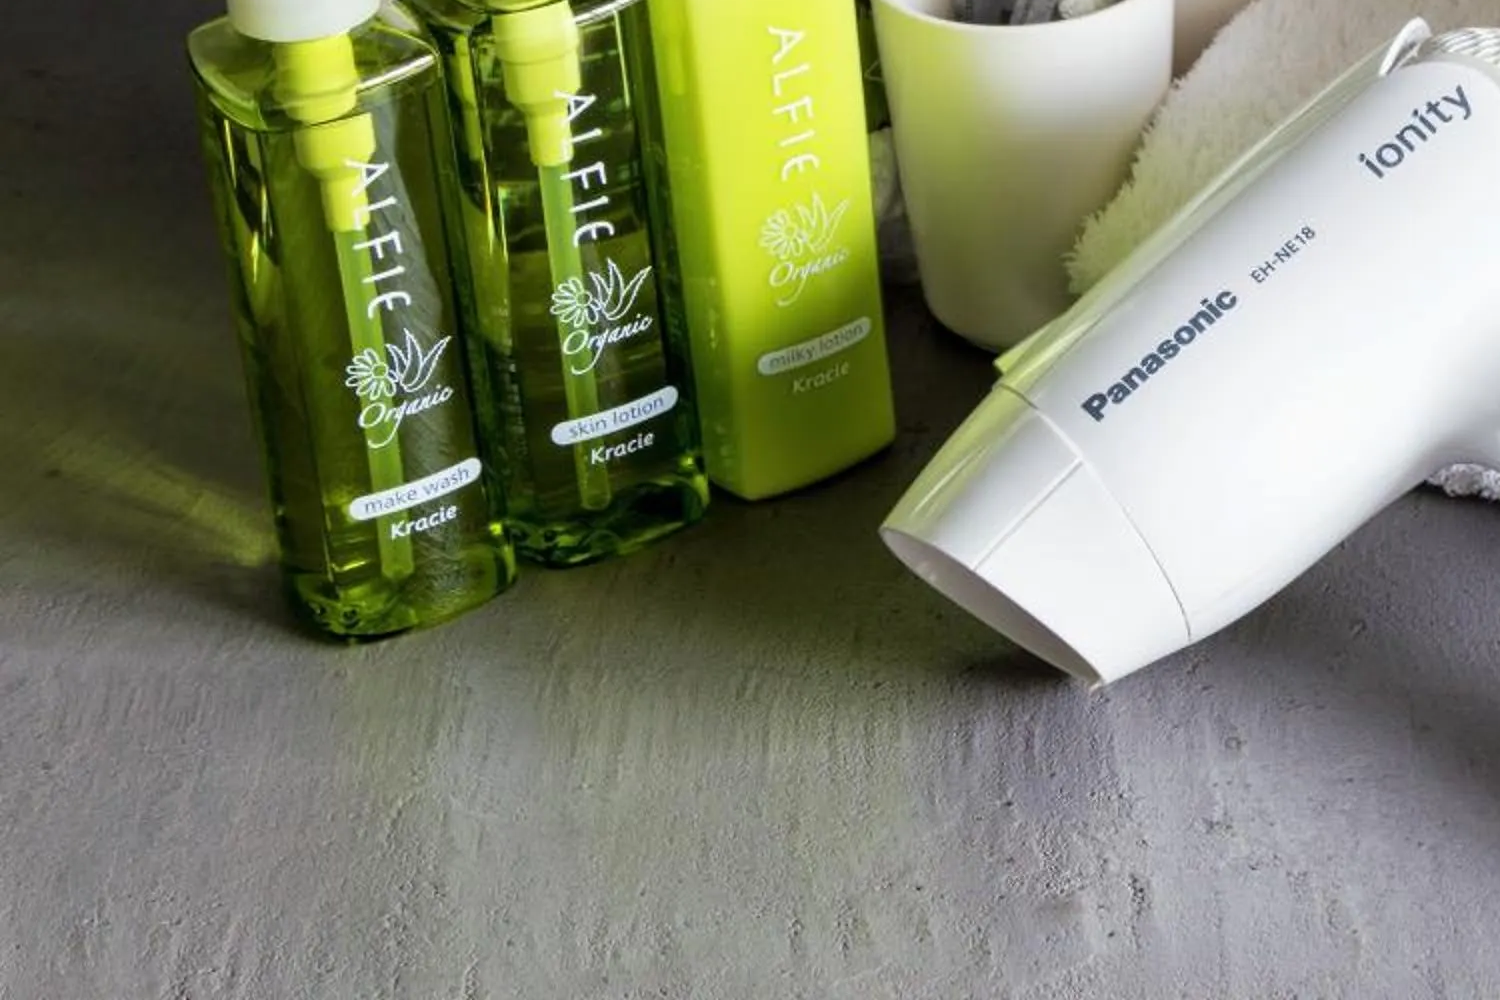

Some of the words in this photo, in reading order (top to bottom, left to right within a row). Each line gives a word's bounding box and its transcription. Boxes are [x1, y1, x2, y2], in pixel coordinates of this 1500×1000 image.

[768, 26, 819, 181] ALFIE
[1359, 84, 1471, 179] ionity
[553, 88, 616, 249] ALFIE
[343, 158, 412, 319] ALFIE
[1250, 225, 1316, 284] EH-NE18
[768, 249, 850, 307] Organic
[563, 313, 654, 376] Organic
[769, 346, 815, 369] milky
[818, 324, 865, 353] lotion
[1080, 290, 1238, 422] Panasonic
[792, 361, 851, 394] Kracie
[358, 384, 454, 448] Organic
[567, 419, 608, 440] skin
[612, 395, 665, 428] lotion
[590, 432, 656, 466] Kracie
[363, 488, 419, 515] make
[421, 464, 471, 496] wash
[391, 505, 458, 539] Kracie
